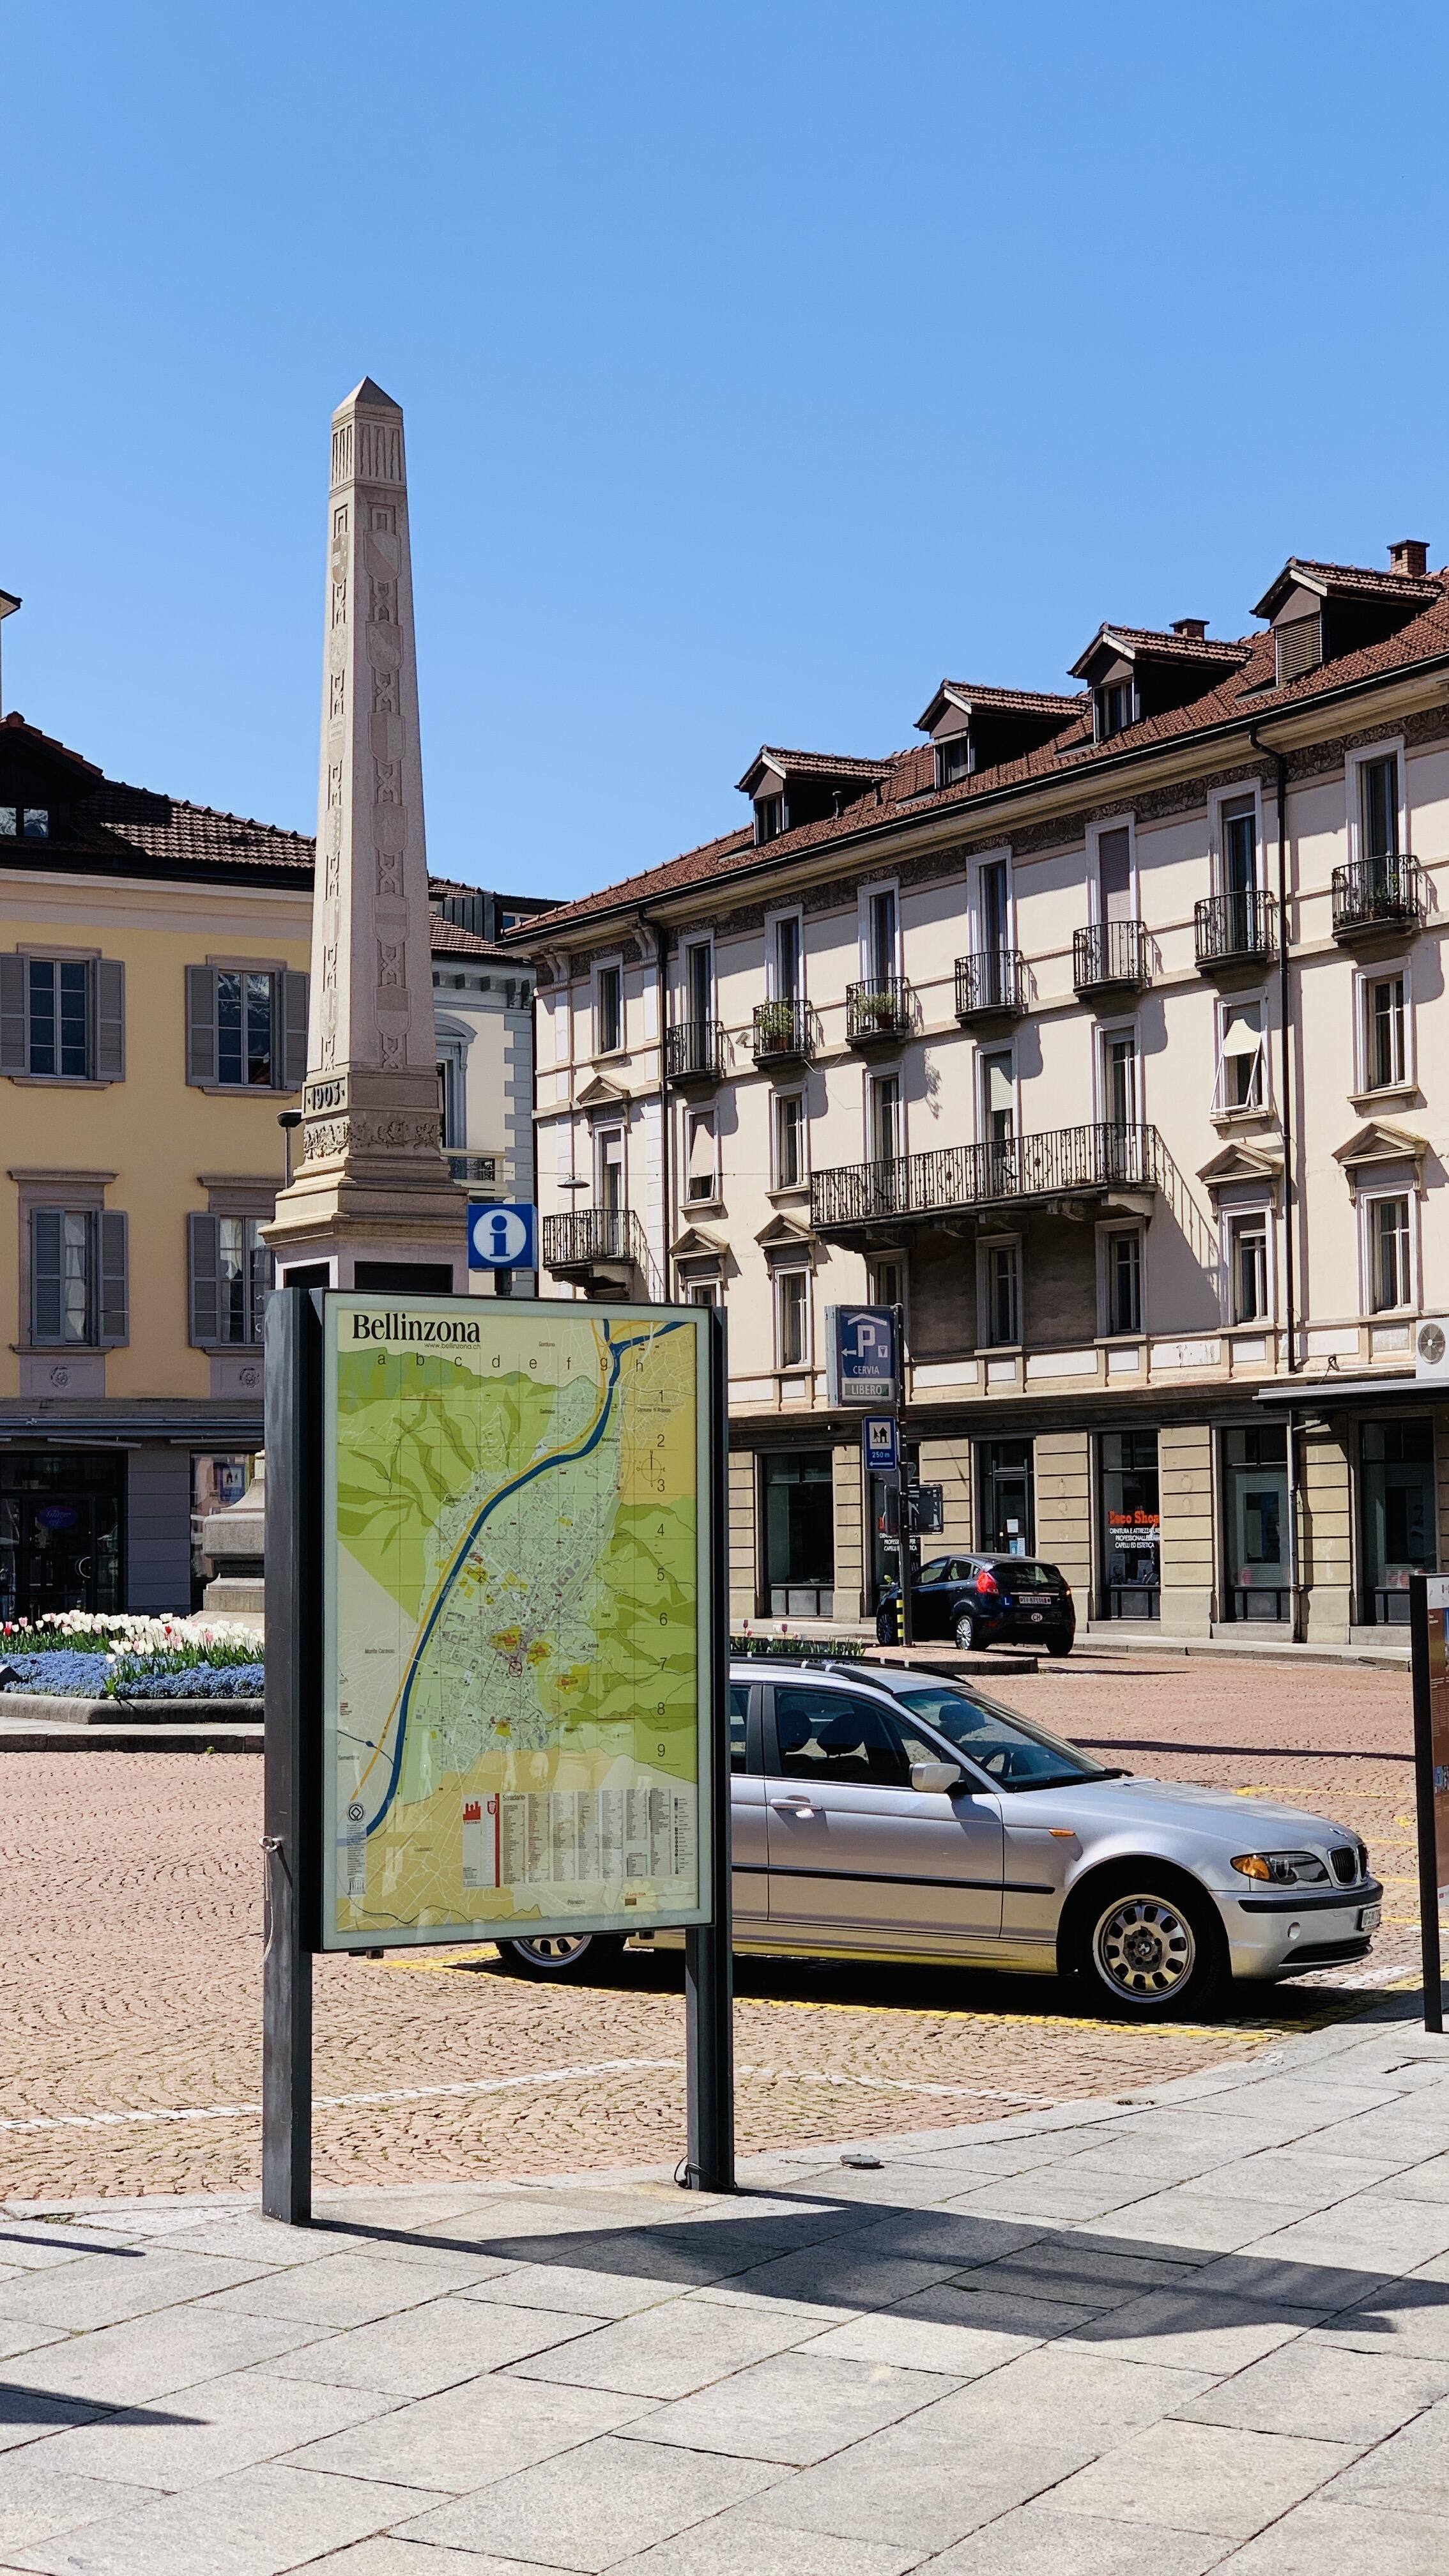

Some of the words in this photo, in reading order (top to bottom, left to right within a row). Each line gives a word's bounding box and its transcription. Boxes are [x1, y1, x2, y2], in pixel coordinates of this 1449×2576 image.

[352, 1312, 480, 1343] Bellinzona
[857, 1324, 876, 1358] P
[378, 1354, 386, 1365] a
[416, 1353, 425, 1366] b
[454, 1356, 463, 1367] c
[491, 1354, 500, 1368] d
[529, 1358, 537, 1369] e
[567, 1357, 572, 1370] f
[600, 1358, 608, 1371] g
[636, 1360, 643, 1372] h
[853, 1365, 880, 1374] CERVIA
[852, 1384, 882, 1395] LIBERO
[657, 1434, 665, 1448] 2
[657, 1479, 666, 1492] 3
[657, 1523, 664, 1537] 4
[657, 1568, 664, 1581] 5
[1004, 1597, 1010, 1606] L
[659, 1613, 668, 1626] 6
[659, 1657, 667, 1671] 7
[657, 1702, 665, 1715] 8
[657, 1744, 665, 1757] 9
